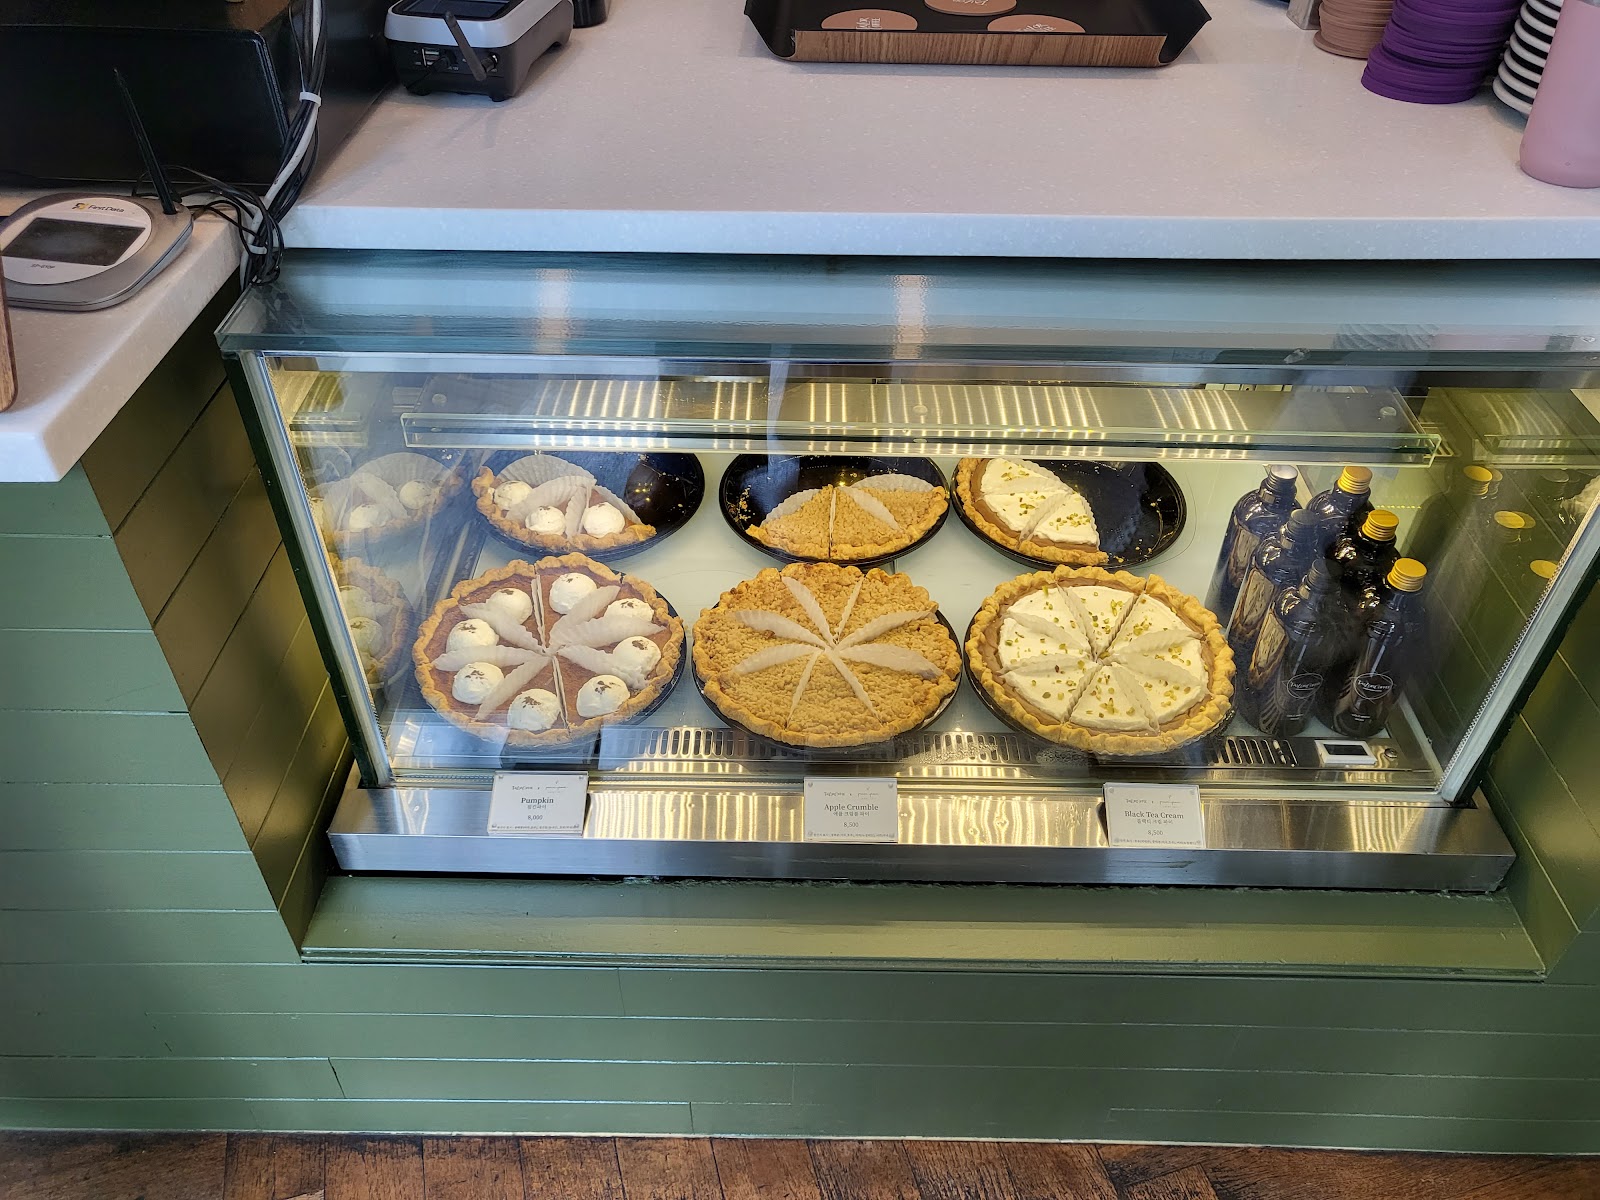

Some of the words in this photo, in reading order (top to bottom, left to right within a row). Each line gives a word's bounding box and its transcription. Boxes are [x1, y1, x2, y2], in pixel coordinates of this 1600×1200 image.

[521, 797, 554, 805] Pumpkin
[824, 804, 846, 812] Apple
[1124, 810, 1145, 818] Black
[1146, 811, 1159, 819] Tea
[1160, 811, 1184, 819] Cream
